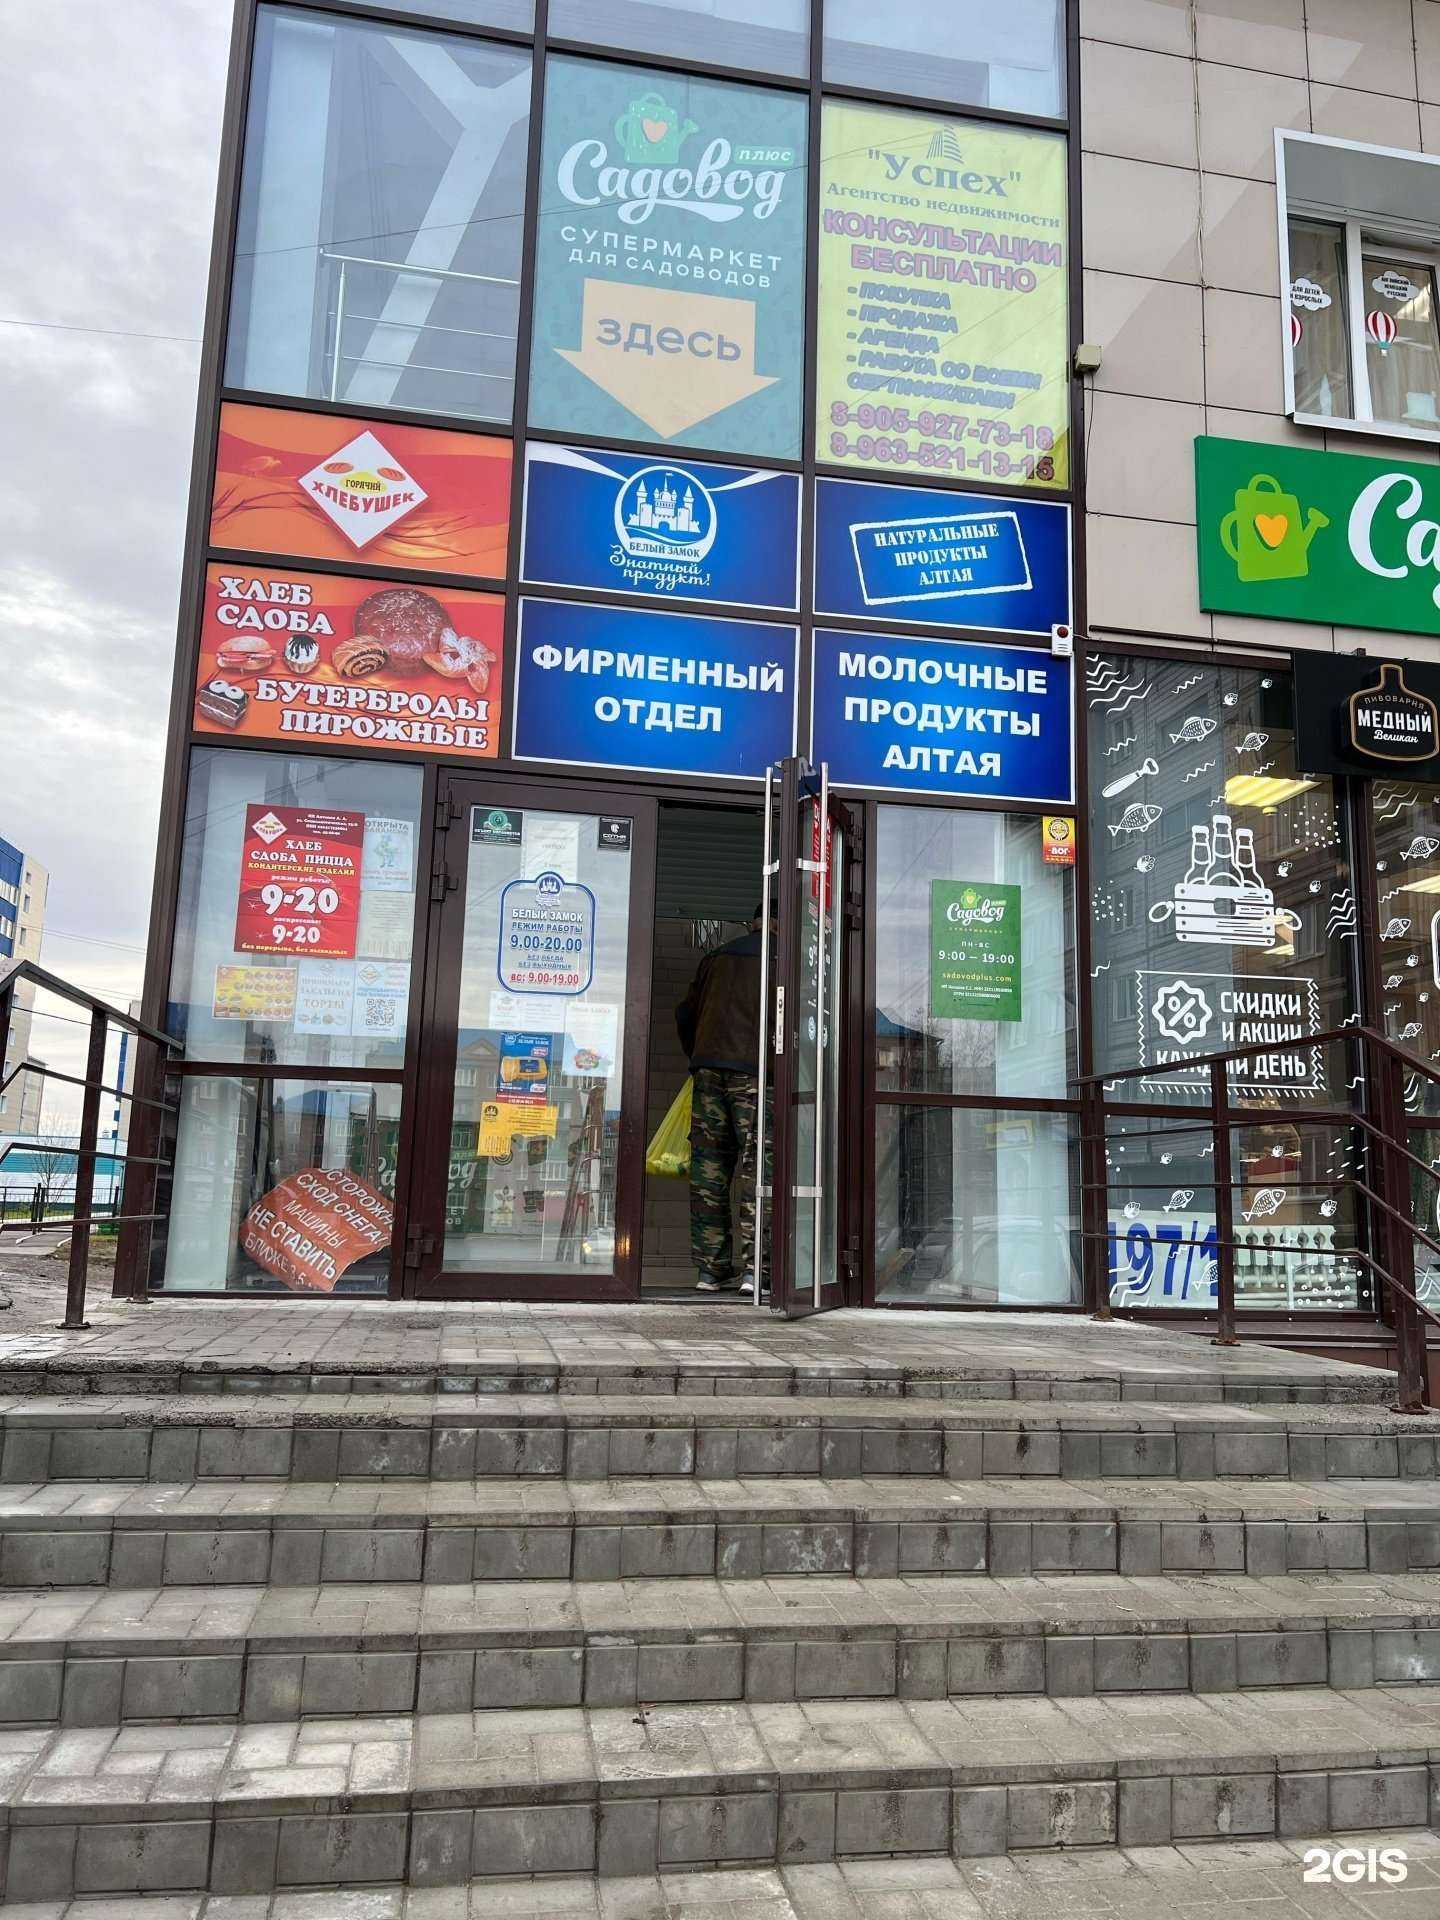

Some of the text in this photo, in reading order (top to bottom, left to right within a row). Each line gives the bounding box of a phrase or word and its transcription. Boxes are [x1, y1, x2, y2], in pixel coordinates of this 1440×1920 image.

[738, 147, 792, 162] плюс
[557, 137, 787, 225] Садовод
[867, 149, 1021, 198] "Успех"
[826, 182, 1061, 229] Агентство недвижимости
[560, 225, 782, 272] СУПЕРМАРКЕТ
[823, 207, 1064, 267] КОНСУЛЬТАЦИИ
[568, 248, 771, 288] ДЛЯ САДОВОДОВ
[850, 242, 1037, 294] БЕСПЛАТНО
[858, 281, 951, 310] ПОКУПКА
[858, 304, 959, 334] ПРОДАЖА
[857, 327, 941, 355] АРЕНДА
[857, 349, 938, 377] РАБОТА
[940, 360, 972, 381] СО
[830, 400, 1055, 452] 8-905-927-73-18
[830, 431, 1056, 482] 8-963-521-13-15
[312, 480, 415, 513] ХЛЕБУШЕК
[345, 479, 381, 491] ГОРЯЧИЙ
[629, 541, 701, 558] БЕЛЫЙ ЗАМОК
[874, 523, 1000, 547] НАТУРАЛЬНЫЕ
[609, 544, 703, 575] Знатный
[894, 545, 989, 567] ПРОДУКТЫ
[217, 575, 313, 607] ХЛЕБ
[623, 568, 711, 591] продукт!
[919, 567, 974, 586] АЛТАЯ
[216, 604, 335, 636] СДОБА
[531, 643, 785, 694] ФИРМЕННЫЙ
[838, 651, 1048, 696] МОЛОЧНЫЕ
[255, 678, 490, 723] БУТЕРБРОДЫ
[593, 696, 722, 733] ОТДЕЛ
[1364, 694, 1425, 710] ПИВОВАРНЯ
[280, 708, 489, 750] ПИРОЖНЫЕ
[844, 696, 1041, 738] ПРОДУКТЫ
[1357, 708, 1432, 733] МЕДНЫЙ
[1373, 729, 1419, 744] Великан
[882, 743, 1001, 777] АЛТАЯ
[251, 851, 354, 868] СДОБА ПИЦЦА
[285, 839, 323, 851] ХЛЕБ
[248, 862, 315, 874] КОНДИТЕРСКИЕ
[316, 867, 355, 876] ИЗДЕЛИЯ
[261, 884, 339, 915] 9-20
[947, 899, 1005, 926] Садовод
[512, 908, 583, 922] БЕЛЫЙ ЗАМОК
[512, 921, 583, 934] РЕЖИМ РАБОТЫ
[272, 924, 321, 944] 9-20
[510, 934, 583, 952] 9.00-20.00
[938, 950, 966, 961] 9:00
[982, 952, 1015, 965] 19:00
[528, 972, 579, 985] 9.00-19.00
[942, 972, 1012, 983] sadovodplus.com
[1220, 991, 1302, 1019] СКИДКИ
[1221, 1021, 1302, 1043] И АКЦИИ
[1253, 1054, 1307, 1080] ДЕНЬ
[282, 1199, 349, 1249] МАШИНЫ
[296, 1173, 339, 1207] СХОД
[334, 1202, 389, 1245] СНЕГА!
[245, 1231, 289, 1273] БЛИЖЕ
[249, 1204, 337, 1280] НЕ СТАВИТЬ
